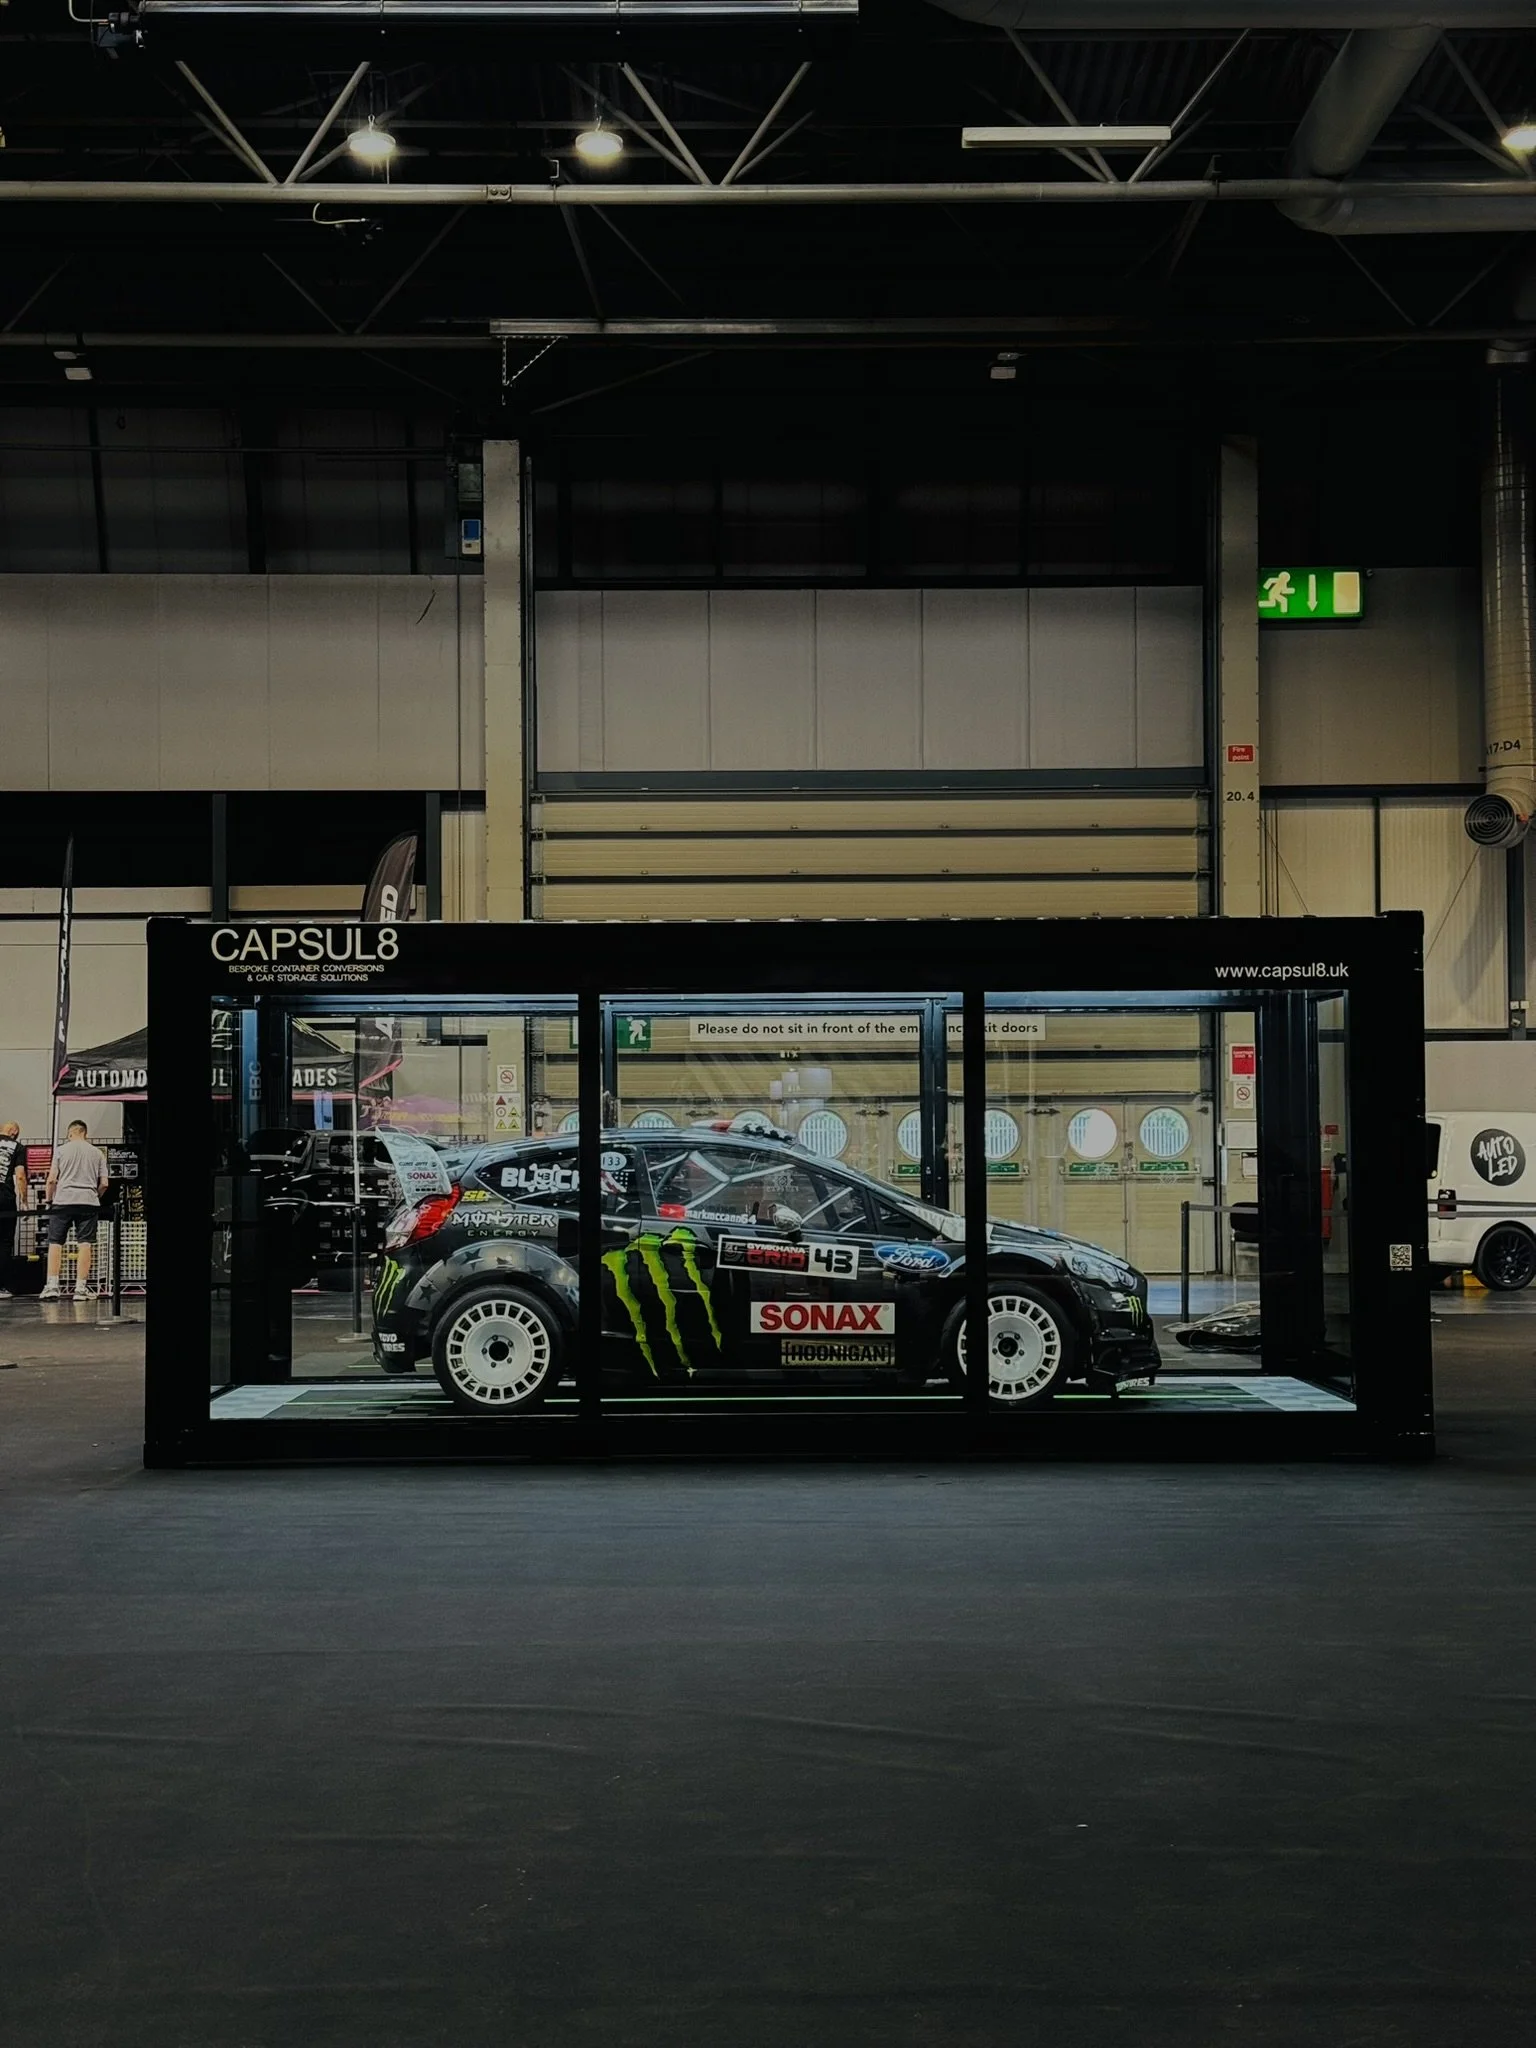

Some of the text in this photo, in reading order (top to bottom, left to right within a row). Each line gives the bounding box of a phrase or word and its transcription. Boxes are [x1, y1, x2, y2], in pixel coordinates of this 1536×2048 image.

[1226, 791, 1255, 801] 20.4
[211, 928, 399, 961] CAPSUL8
[229, 965, 268, 973] BESPOKE
[247, 974, 368, 982] & CAR STORAGE SOLUTIONS
[1215, 962, 1349, 981] www.capsul8.uk
[698, 1023, 738, 1034] Please
[742, 1023, 759, 1034] do
[763, 1024, 784, 1034] not
[788, 1023, 803, 1034] sit
[807, 1023, 818, 1033] in
[823, 1022, 854, 1033] front
[857, 1022, 871, 1033] of
[875, 1022, 896, 1033] the
[1001, 1022, 1038, 1033] doors
[75, 1069, 147, 1088] AUTOMO
[292, 1067, 337, 1087] ADES
[1477, 1136, 1514, 1161] AUTO
[406, 1171, 438, 1180] SONAX
[1488, 1155, 1517, 1181] LED
[814, 1248, 854, 1274] 43
[890, 1246, 934, 1268] Ford
[759, 1304, 883, 1331] SONAX
